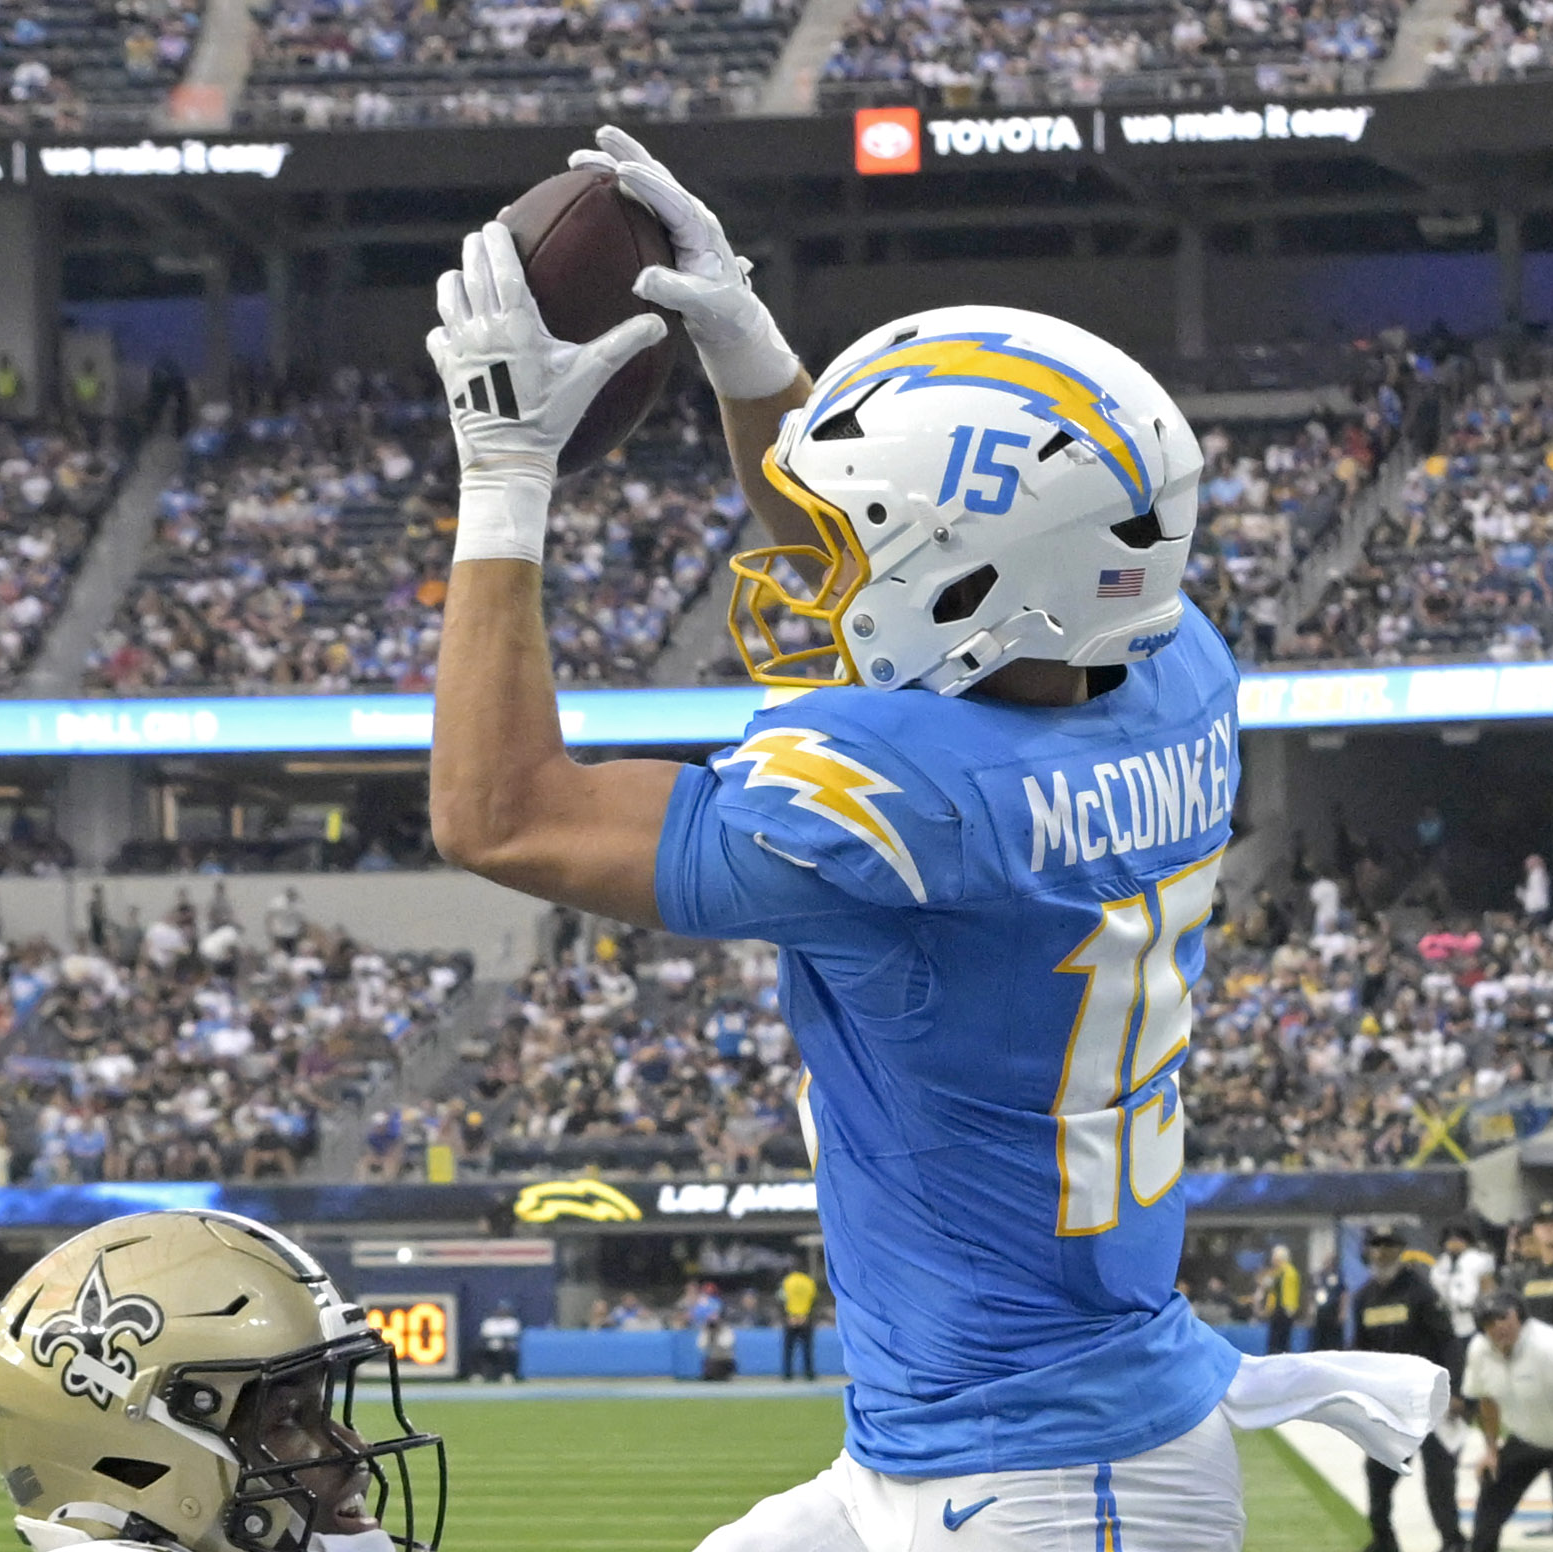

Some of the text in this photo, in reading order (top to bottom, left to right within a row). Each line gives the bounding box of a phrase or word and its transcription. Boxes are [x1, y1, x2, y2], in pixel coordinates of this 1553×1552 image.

[928, 115, 1082, 155] TOYOTA
[1120, 114, 1174, 142] we
[1174, 105, 1263, 142] make
[1290, 105, 1375, 142] easy
[39, 147, 92, 177] we
[92, 140, 181, 176] make
[207, 142, 292, 179] easy
[936, 424, 1032, 516] 15
[1052, 842, 1230, 1237] 15
[366, 1302, 446, 1366] 40
